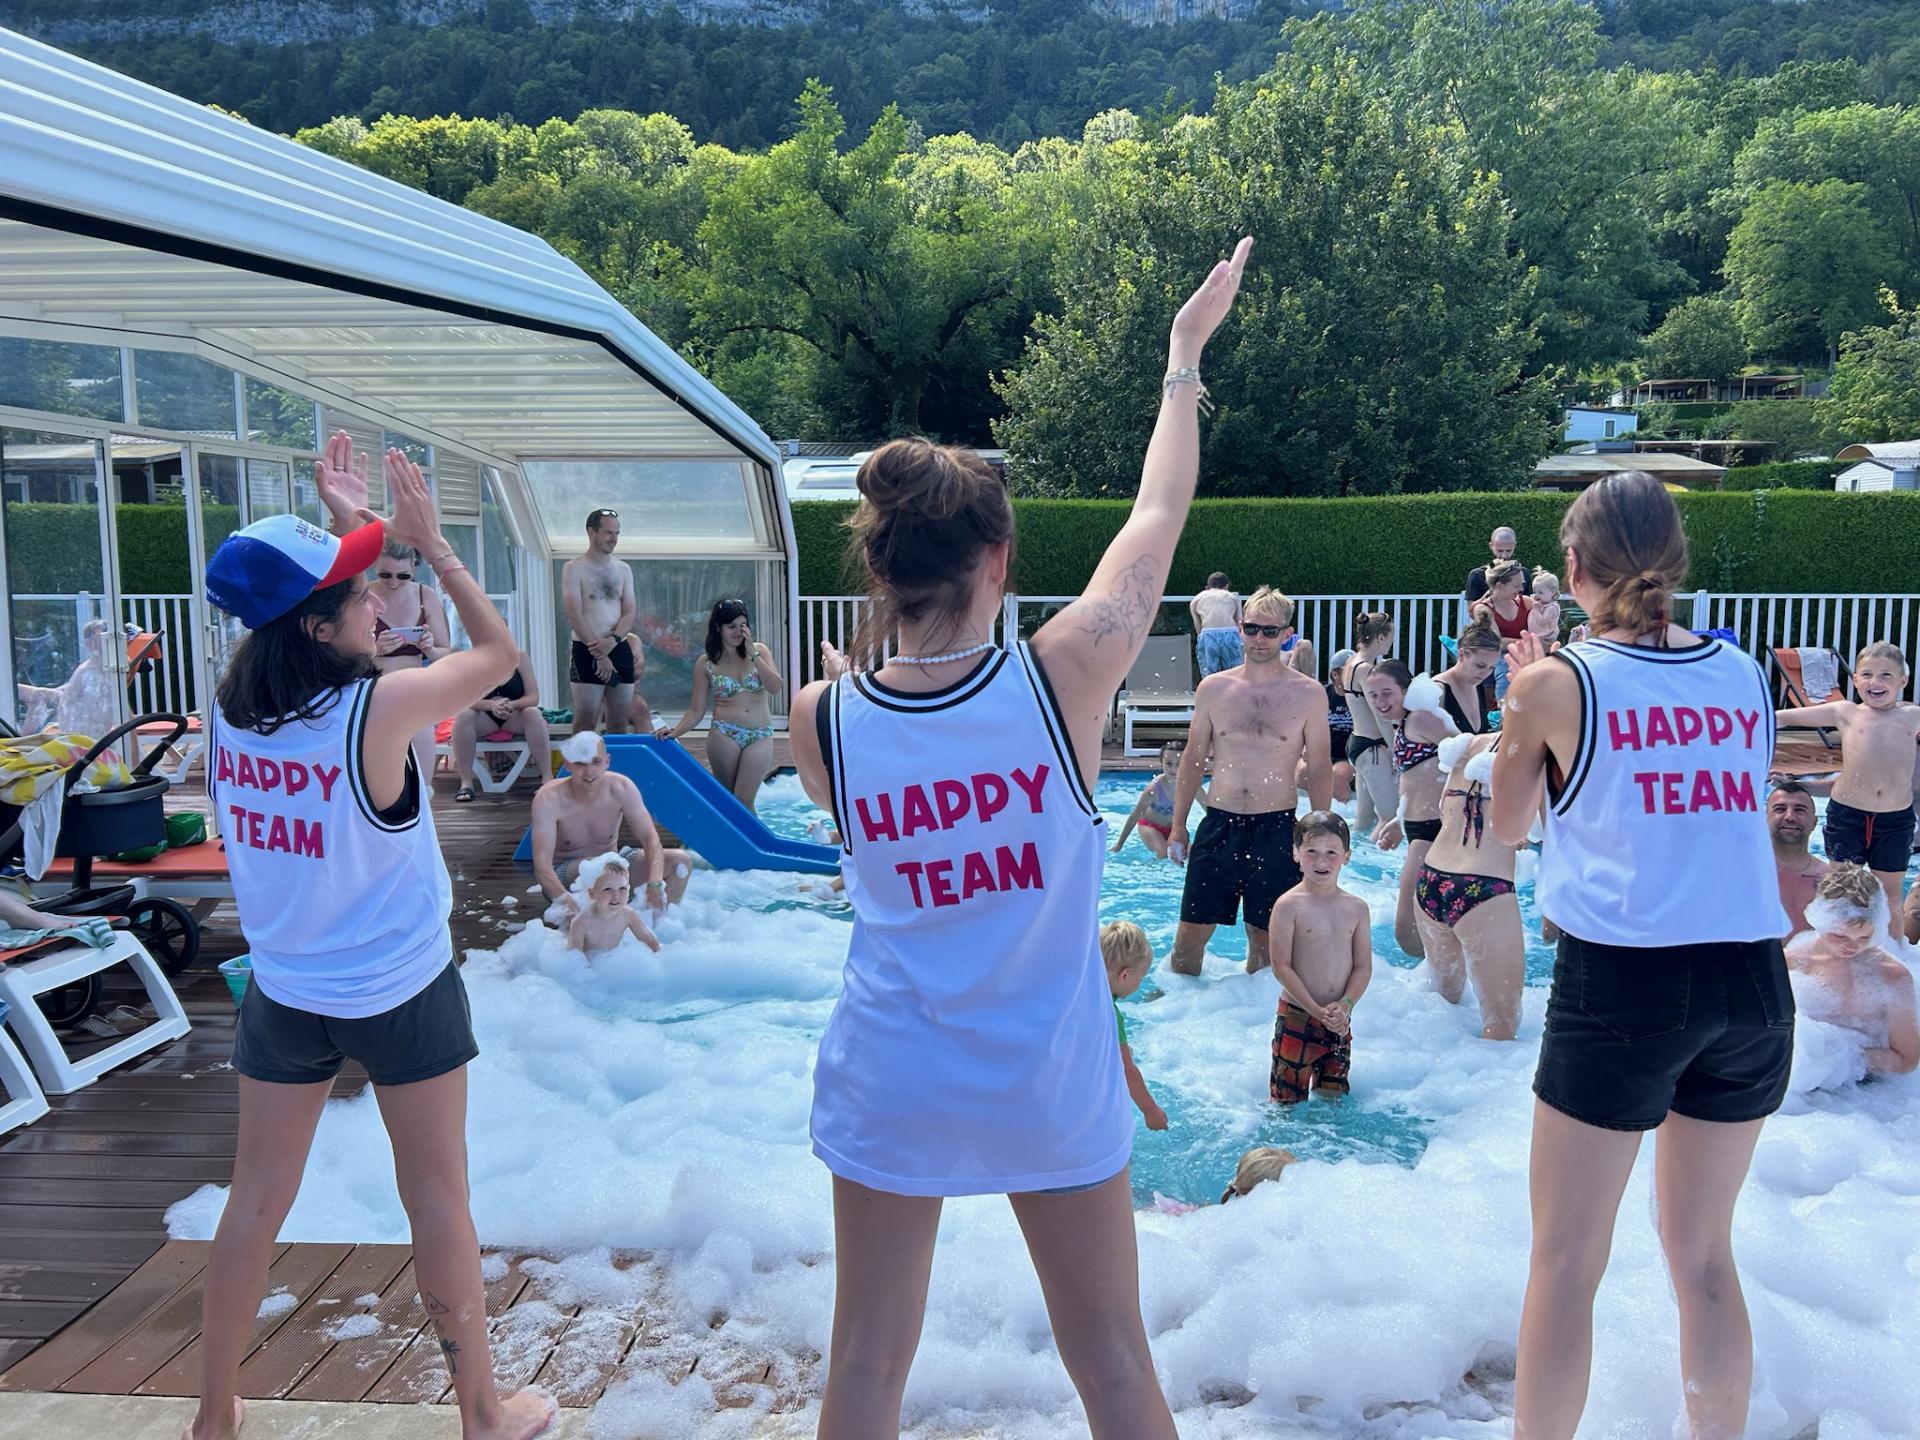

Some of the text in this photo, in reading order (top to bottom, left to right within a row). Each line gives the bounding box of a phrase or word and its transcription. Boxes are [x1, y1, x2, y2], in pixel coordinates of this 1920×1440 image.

[1607, 705, 1760, 751] HAPPY
[217, 745, 341, 801] HAPPY
[1633, 769, 1757, 815] TEAM
[855, 764, 1050, 842] HAPPY
[229, 804, 324, 859] TEAM
[895, 842, 1045, 908] TEAM
